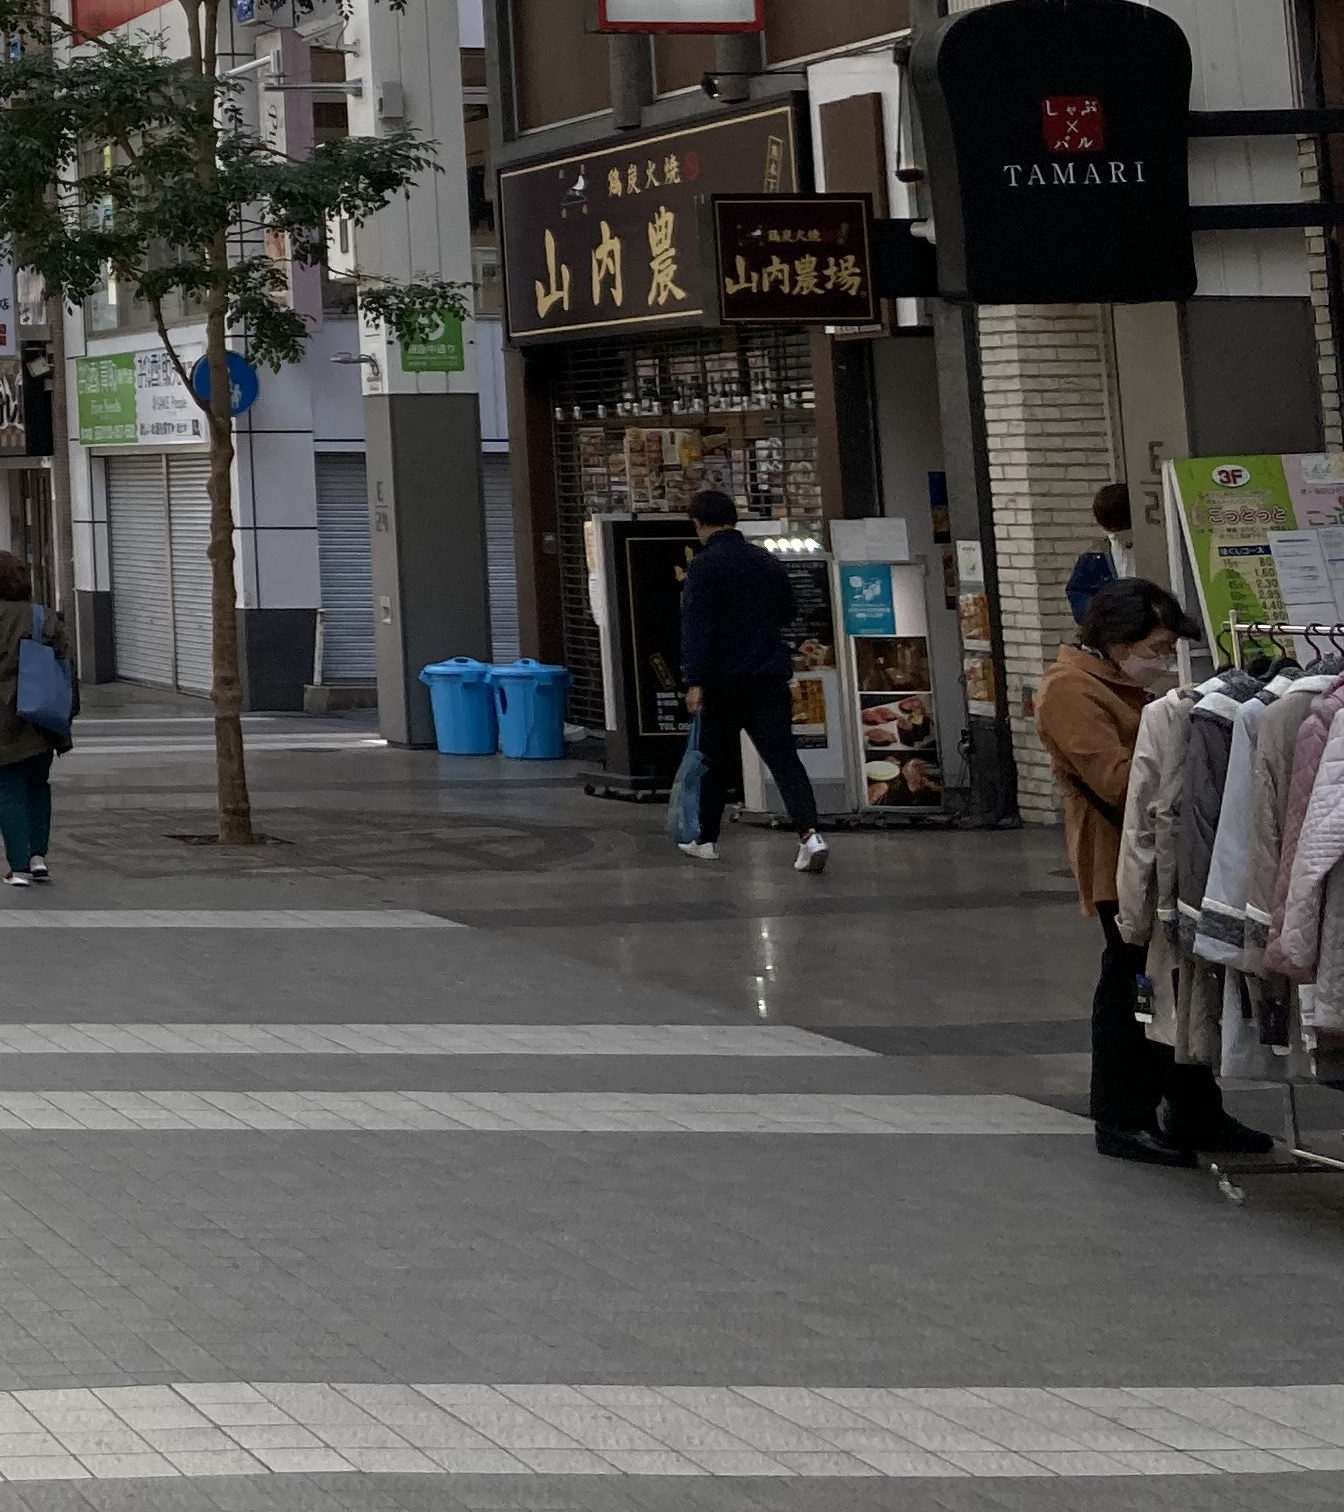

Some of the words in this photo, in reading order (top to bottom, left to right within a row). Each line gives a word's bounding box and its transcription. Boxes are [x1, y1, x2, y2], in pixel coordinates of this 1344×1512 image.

[1002, 159, 1148, 188] TAMARI
[724, 253, 862, 297] 山内農場
[1216, 469, 1243, 485] 3F
